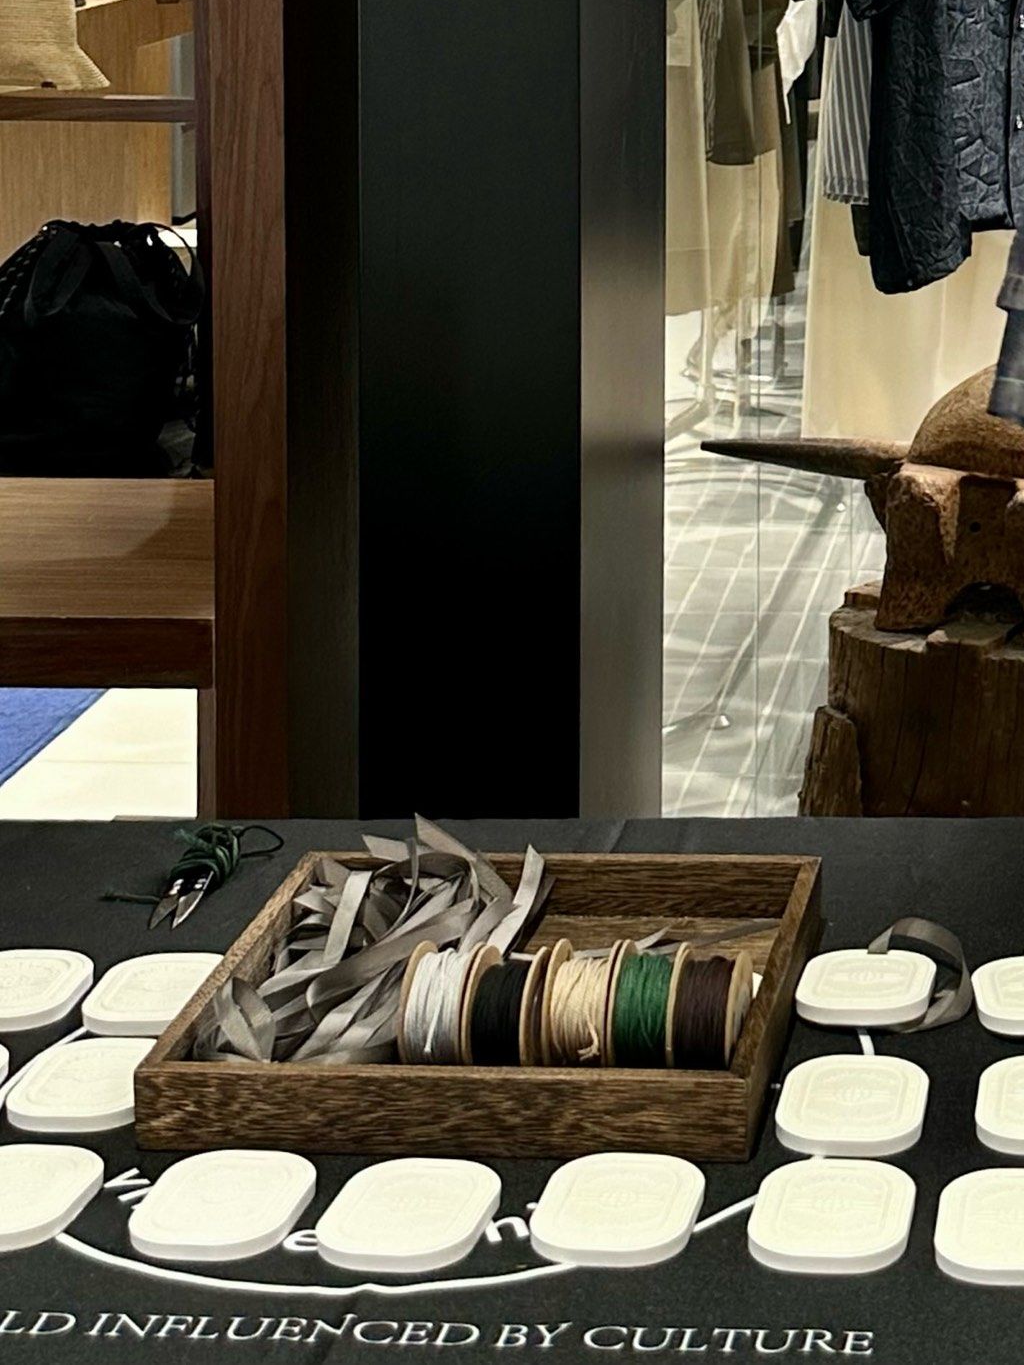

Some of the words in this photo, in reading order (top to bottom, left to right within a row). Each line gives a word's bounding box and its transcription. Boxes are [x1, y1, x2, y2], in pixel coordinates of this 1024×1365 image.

[84, 1312, 481, 1348] INFLUENCED
[495, 1321, 573, 1349] BY
[583, 1326, 874, 1356] CULTURE
